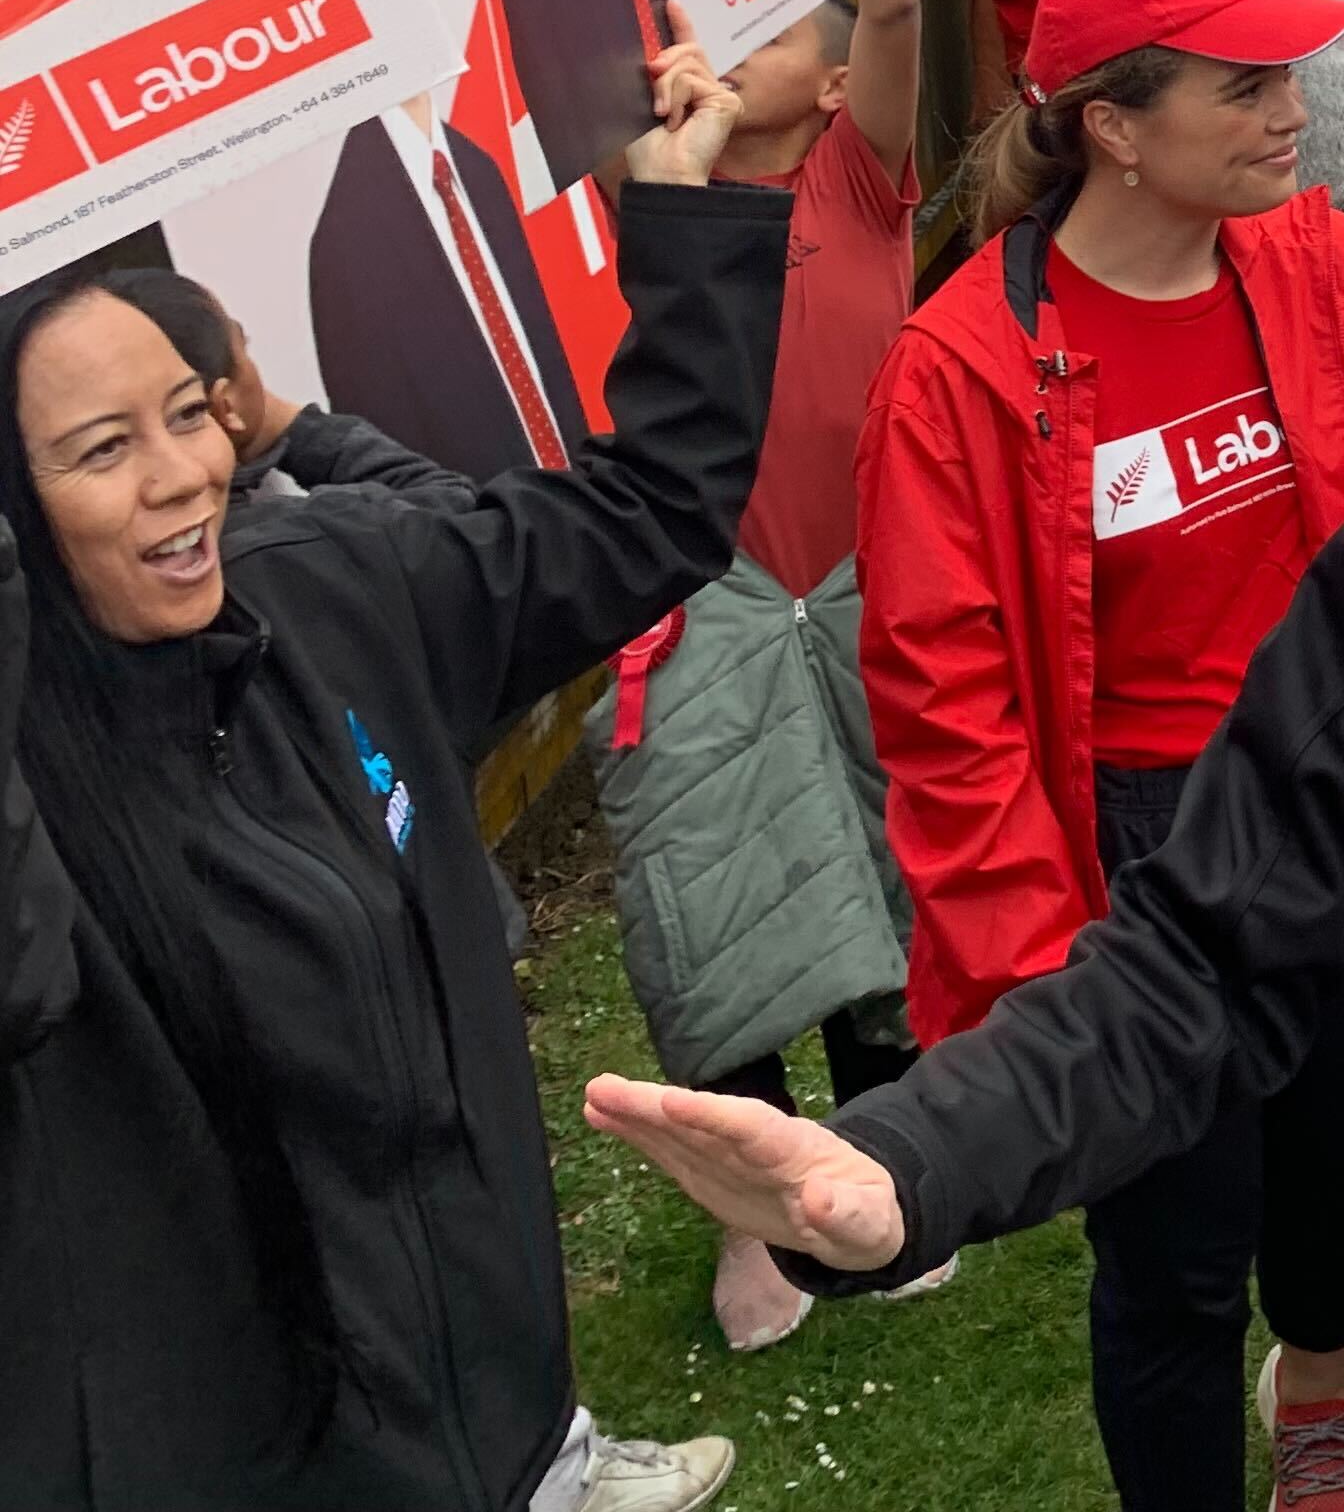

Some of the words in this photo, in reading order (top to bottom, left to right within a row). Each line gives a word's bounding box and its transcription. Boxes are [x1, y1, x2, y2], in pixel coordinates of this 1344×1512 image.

[98, 167, 178, 208] Featherston
[331, 79, 356, 100] 384
[357, 64, 389, 85] 7649
[1184, 414, 1287, 485] Lab
